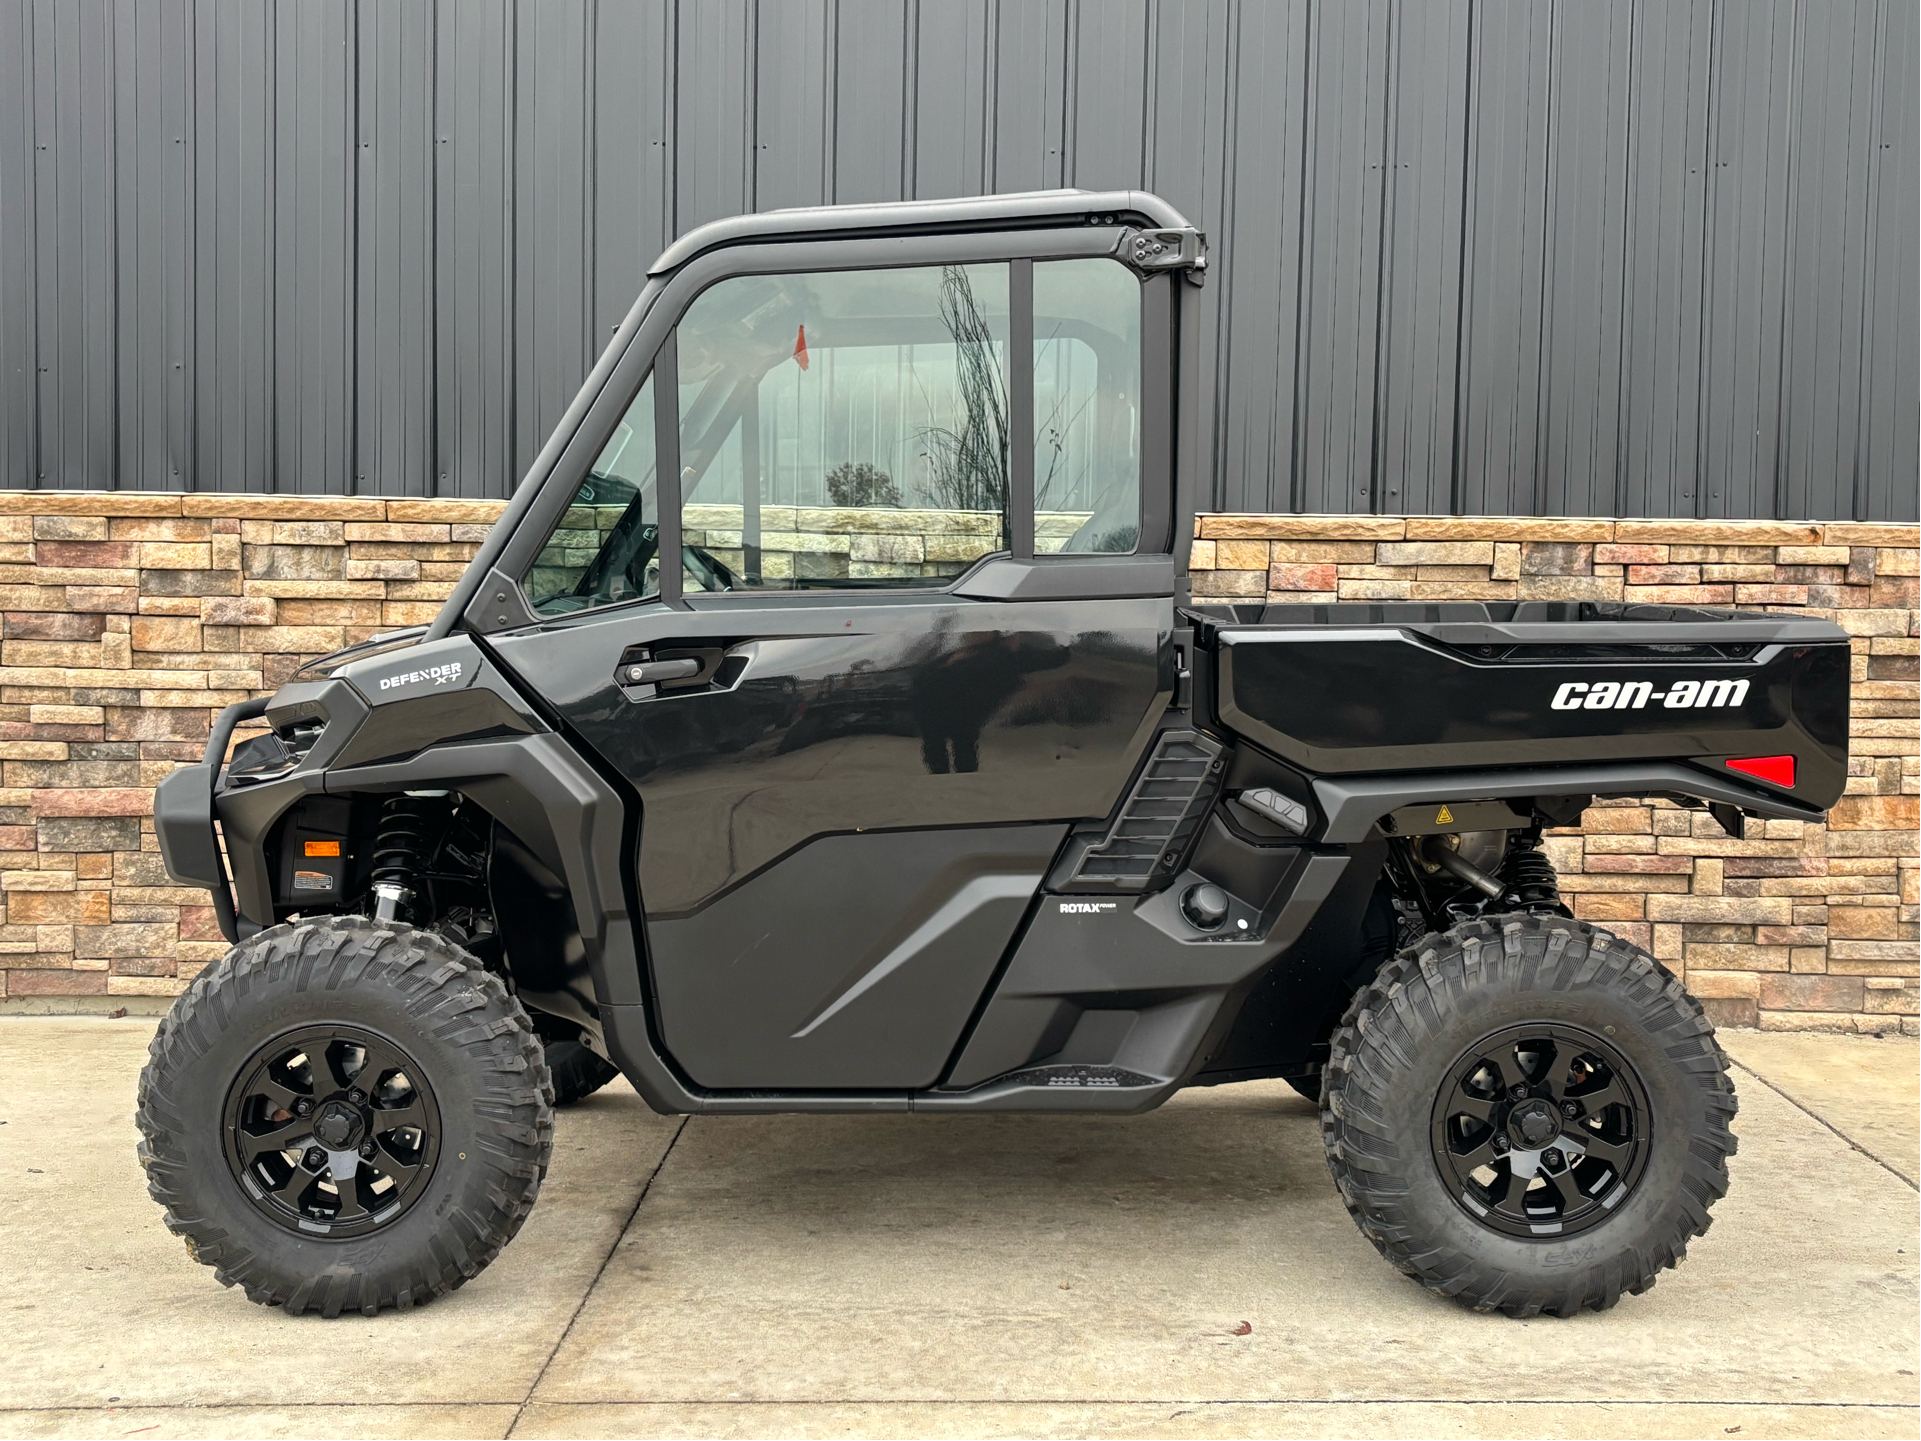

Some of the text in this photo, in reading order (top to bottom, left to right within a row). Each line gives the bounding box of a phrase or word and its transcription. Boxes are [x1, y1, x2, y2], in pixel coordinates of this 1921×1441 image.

[379, 662, 462, 690] DEFENDER
[434, 672, 462, 686] XT
[1550, 679, 1750, 710] can-am
[1059, 903, 1100, 913] ROTAX
